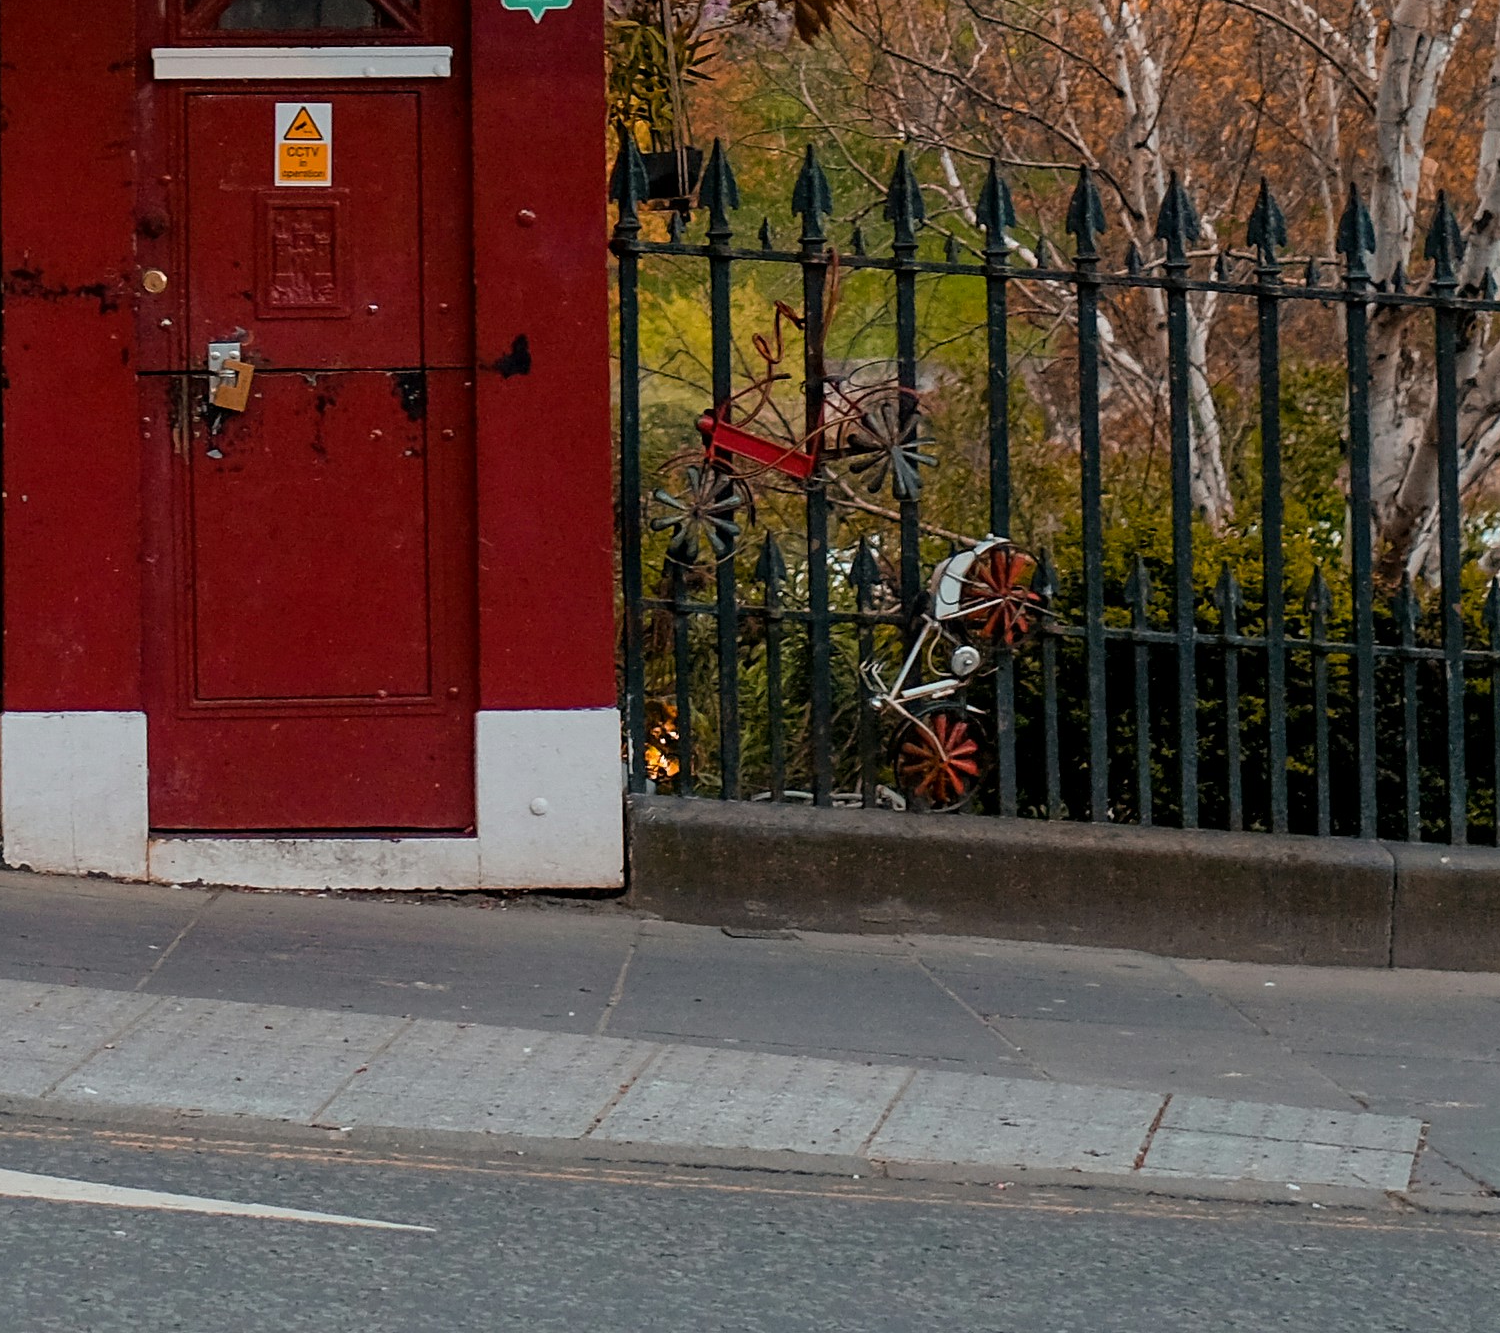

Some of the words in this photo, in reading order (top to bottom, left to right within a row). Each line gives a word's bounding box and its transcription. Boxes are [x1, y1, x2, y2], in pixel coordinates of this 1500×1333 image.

[286, 146, 320, 158] CCTV
[299, 159, 307, 167] in
[281, 169, 325, 178] operation
